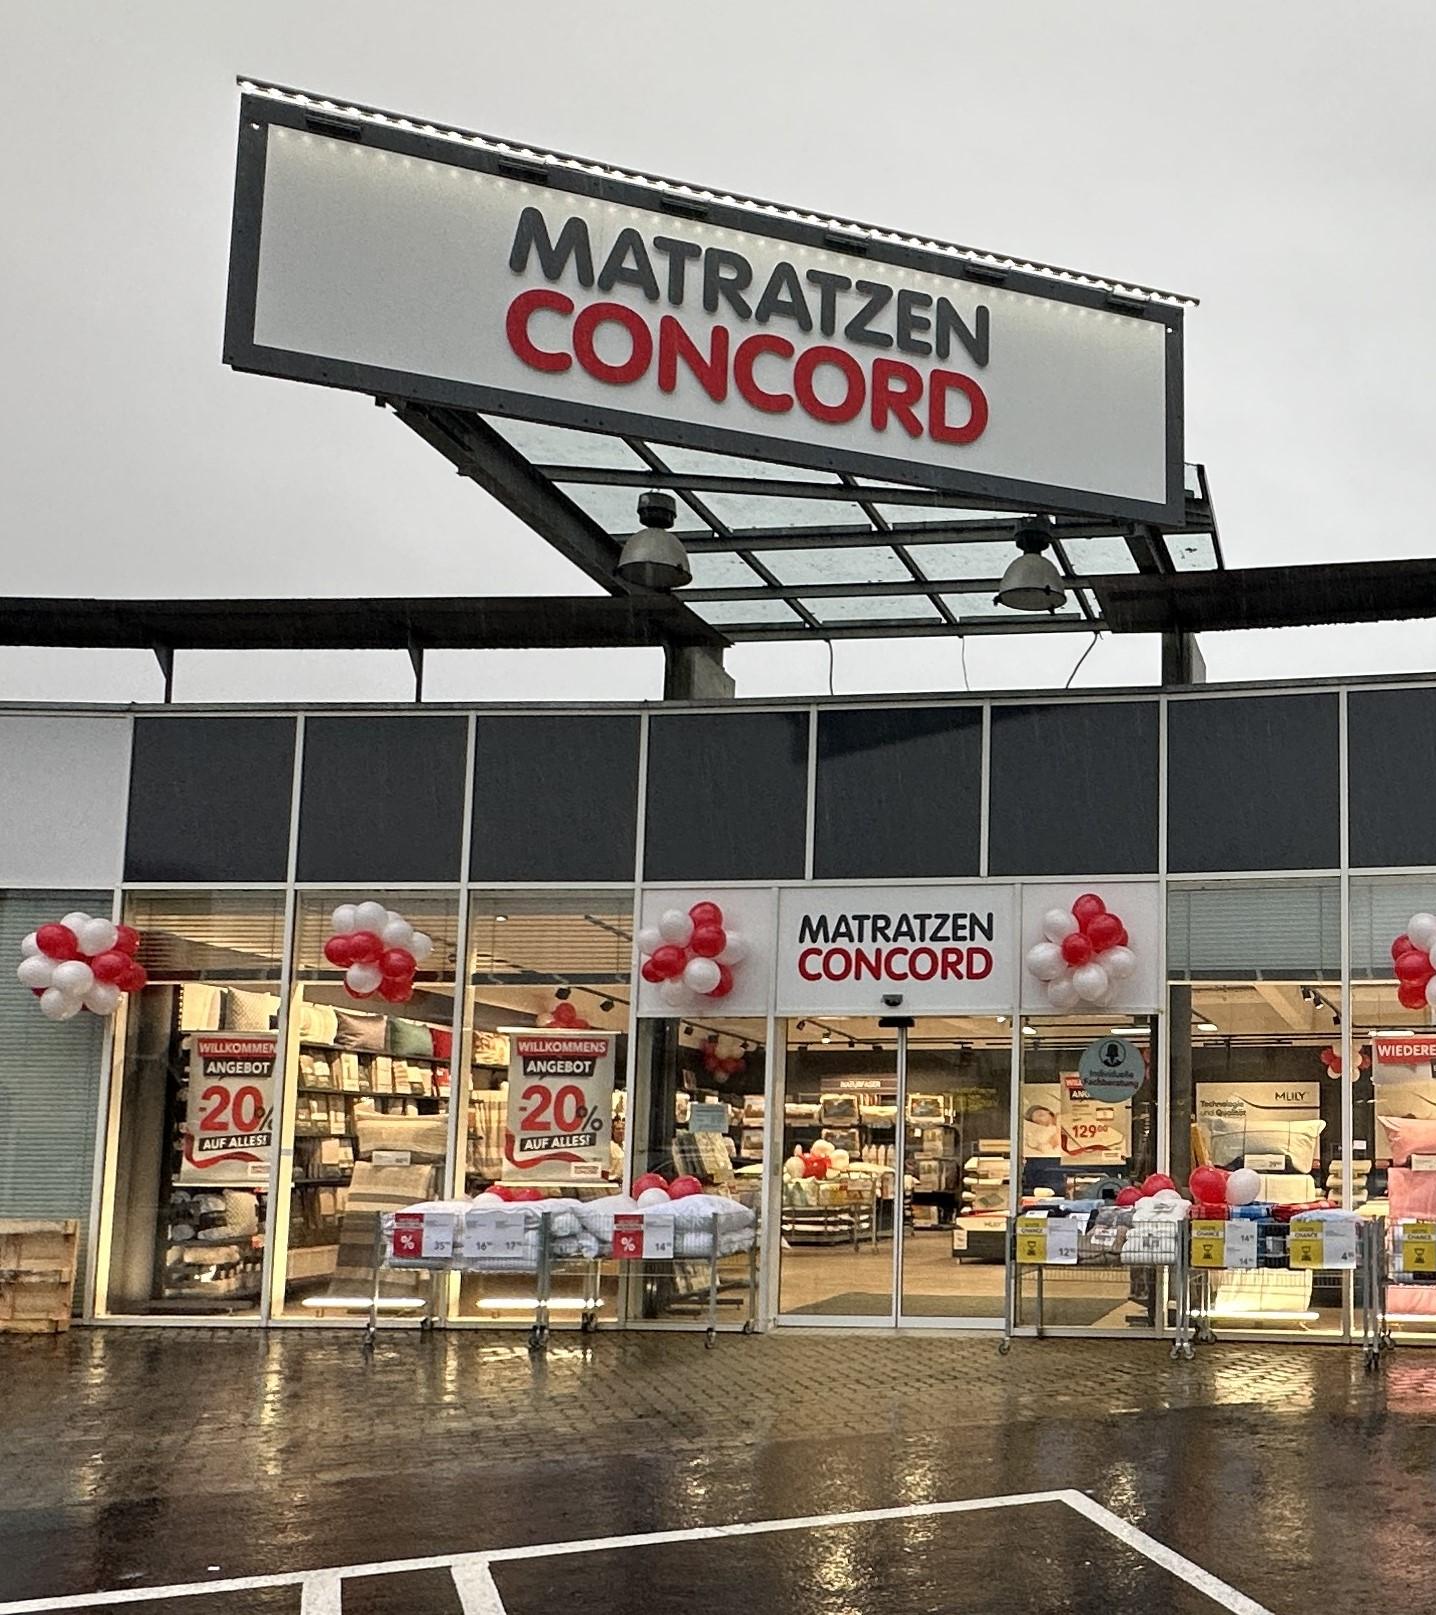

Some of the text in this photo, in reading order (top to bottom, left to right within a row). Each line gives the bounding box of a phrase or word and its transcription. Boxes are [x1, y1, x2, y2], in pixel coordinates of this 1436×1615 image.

[508, 206, 990, 367] MATRATZEN
[506, 288, 989, 445] CONCORD
[798, 912, 994, 944] MATRATZEN
[798, 947, 994, 981] CONCORD
[199, 1042, 276, 1053] WILLKOMMEN
[518, 1041, 607, 1053] WILLKOMMENS
[206, 1061, 271, 1075] ANGEBOT
[526, 1060, 592, 1073] ANGEBOT
[203, 1134, 267, 1150] AUF ALLES!
[524, 1134, 591, 1150] AUF ALLES!
[400, 1234, 415, 1250] %
[621, 1237, 636, 1252] %
